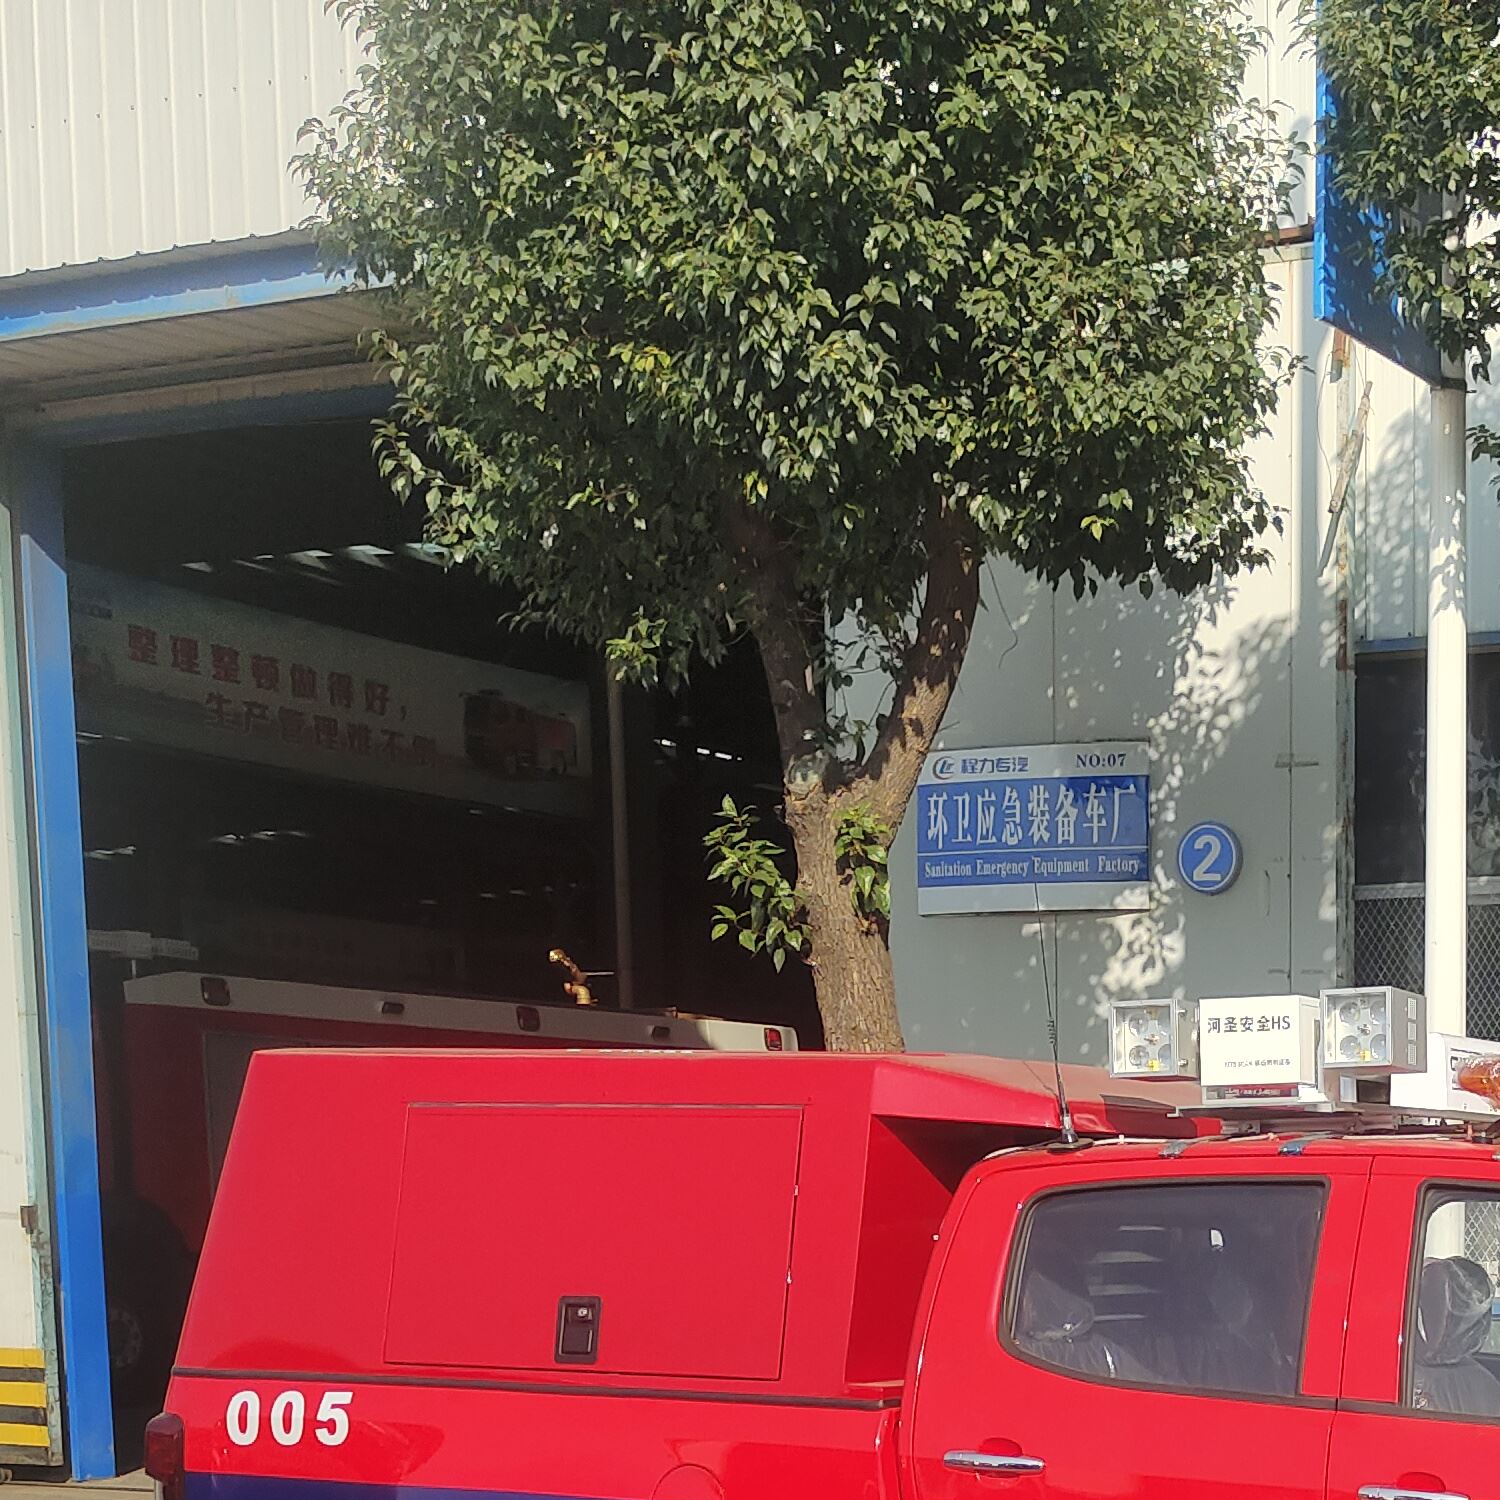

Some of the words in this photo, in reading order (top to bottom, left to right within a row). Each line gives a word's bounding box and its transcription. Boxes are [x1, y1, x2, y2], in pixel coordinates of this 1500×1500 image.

[960, 756, 1029, 774] 程力专汽
[1075, 752, 1127, 769] NO:07
[927, 782, 1137, 850] 环卫应急装备车厂
[924, 860, 972, 878] Sanitation
[975, 858, 1029, 878] Emergency
[1033, 856, 1089, 876] Equipment
[1097, 855, 1140, 875] Factory
[1192, 834, 1222, 882] 2
[225, 1390, 354, 1446] 005
